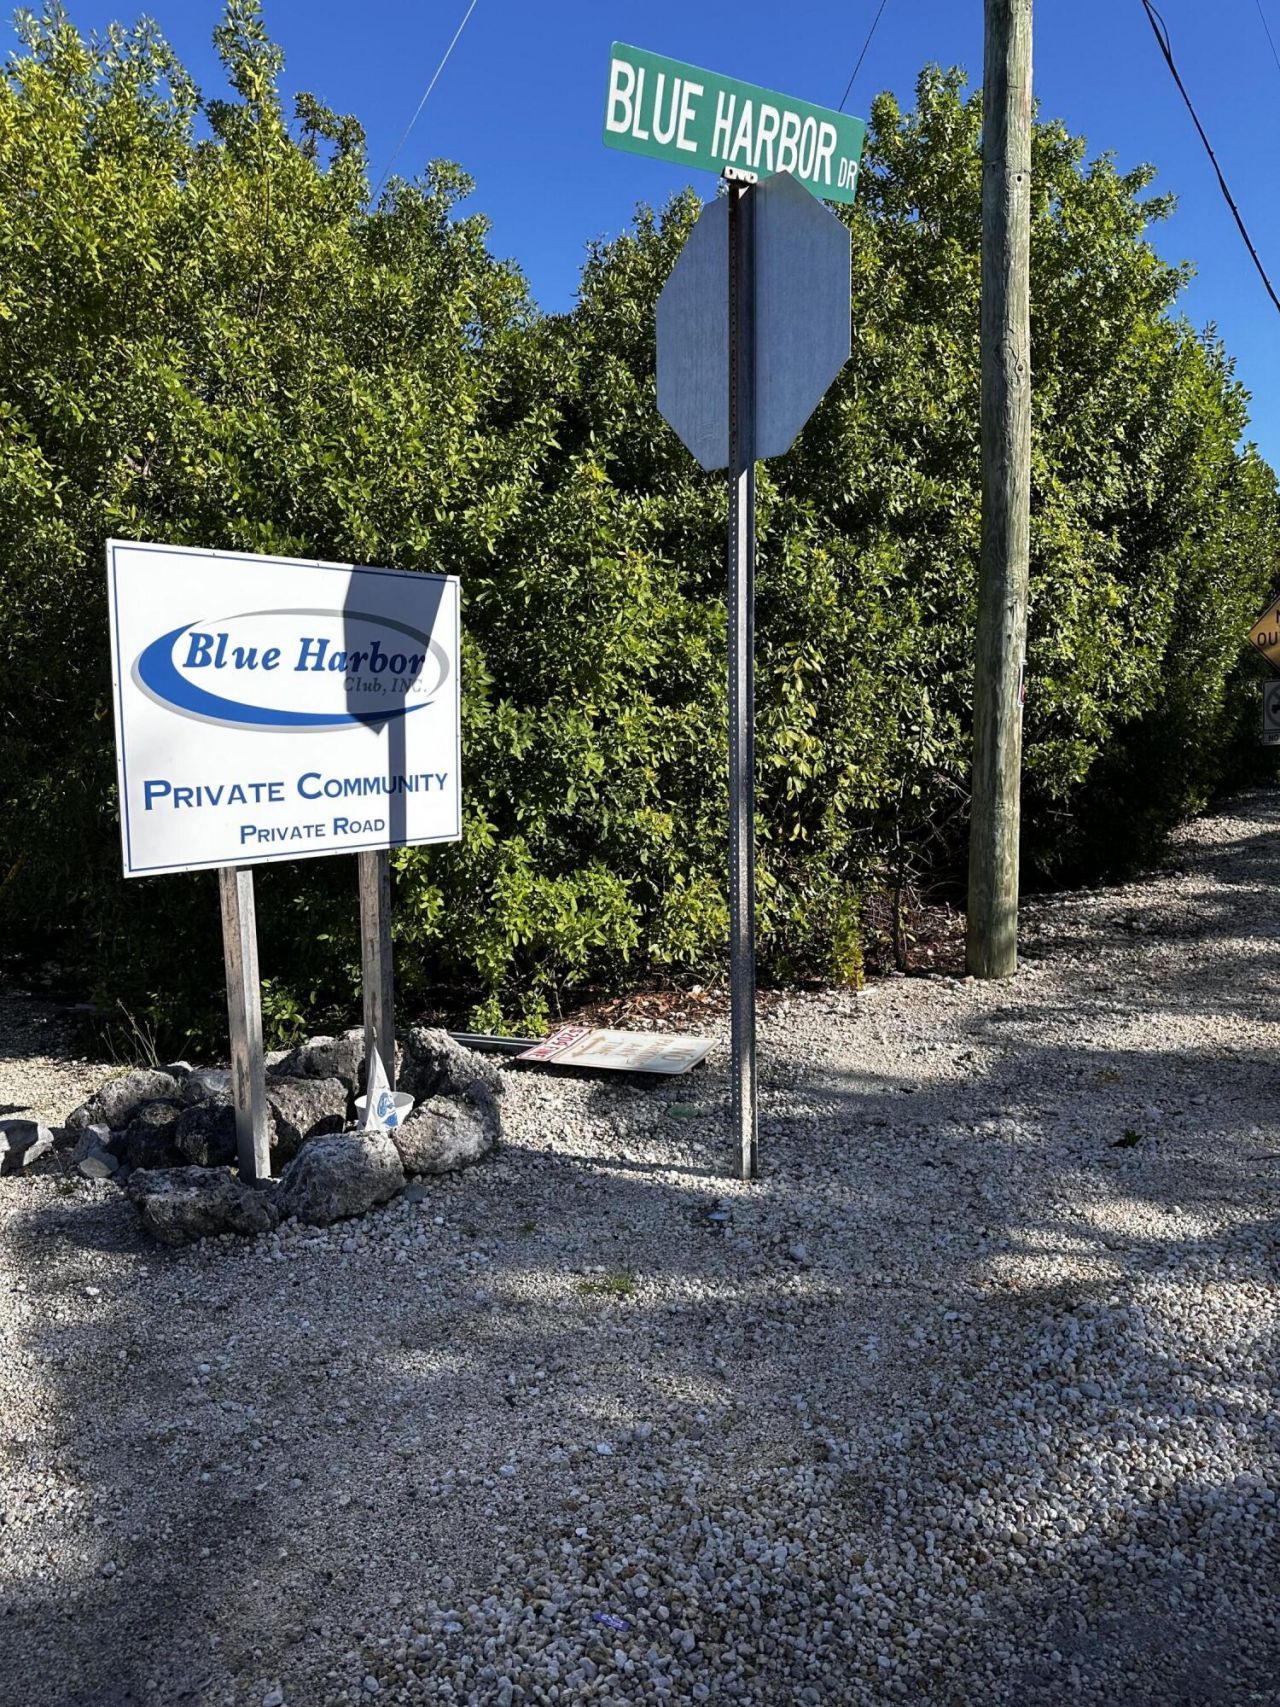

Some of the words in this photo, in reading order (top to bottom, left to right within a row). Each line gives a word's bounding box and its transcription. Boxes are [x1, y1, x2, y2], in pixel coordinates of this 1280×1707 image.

[606, 58, 704, 153] BLUE
[711, 90, 837, 186] HARBOR
[837, 156, 858, 191] DR
[182, 632, 281, 671] Blue
[293, 637, 426, 675] Harbor
[343, 676, 387, 696] Club,
[144, 779, 285, 811] PRIVATE
[297, 772, 449, 800] COMMUNITY
[240, 824, 327, 845] PRIVATE
[333, 817, 386, 836] ROAD
